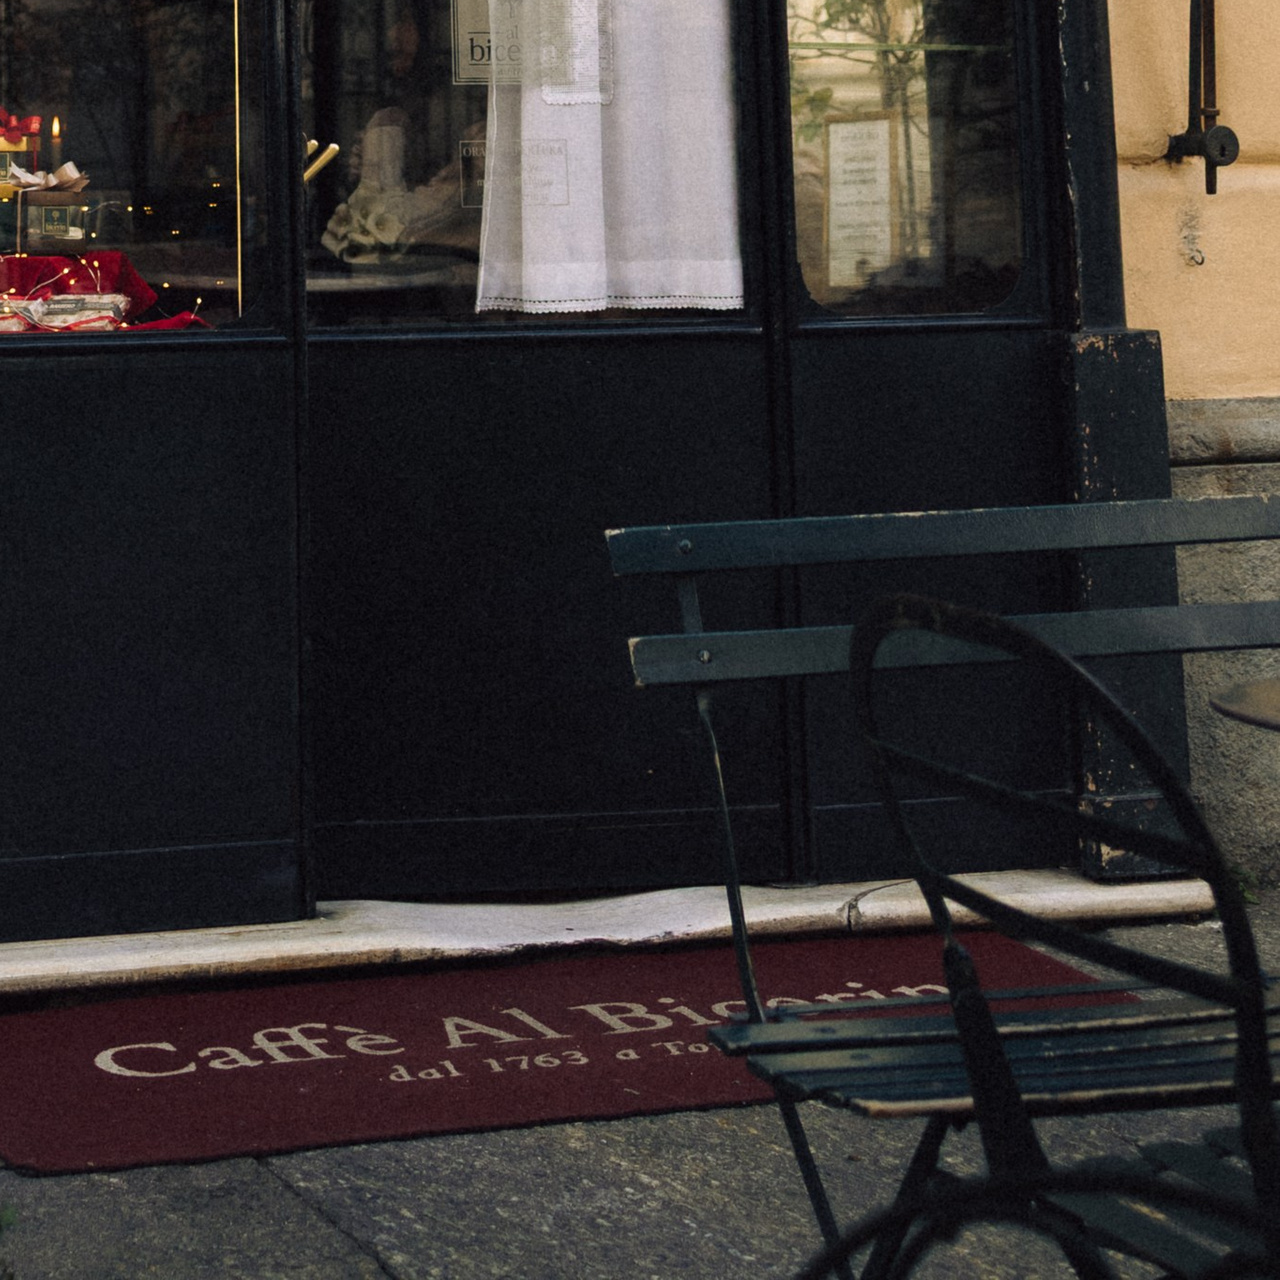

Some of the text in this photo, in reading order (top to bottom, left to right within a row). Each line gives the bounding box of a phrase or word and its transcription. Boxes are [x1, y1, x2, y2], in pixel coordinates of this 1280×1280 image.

[94, 1023, 406, 1078] Caffè
[442, 1007, 572, 1049] Al
[388, 1059, 463, 1082] dal
[483, 1050, 590, 1072] 1763
[615, 1048, 642, 1061] a
